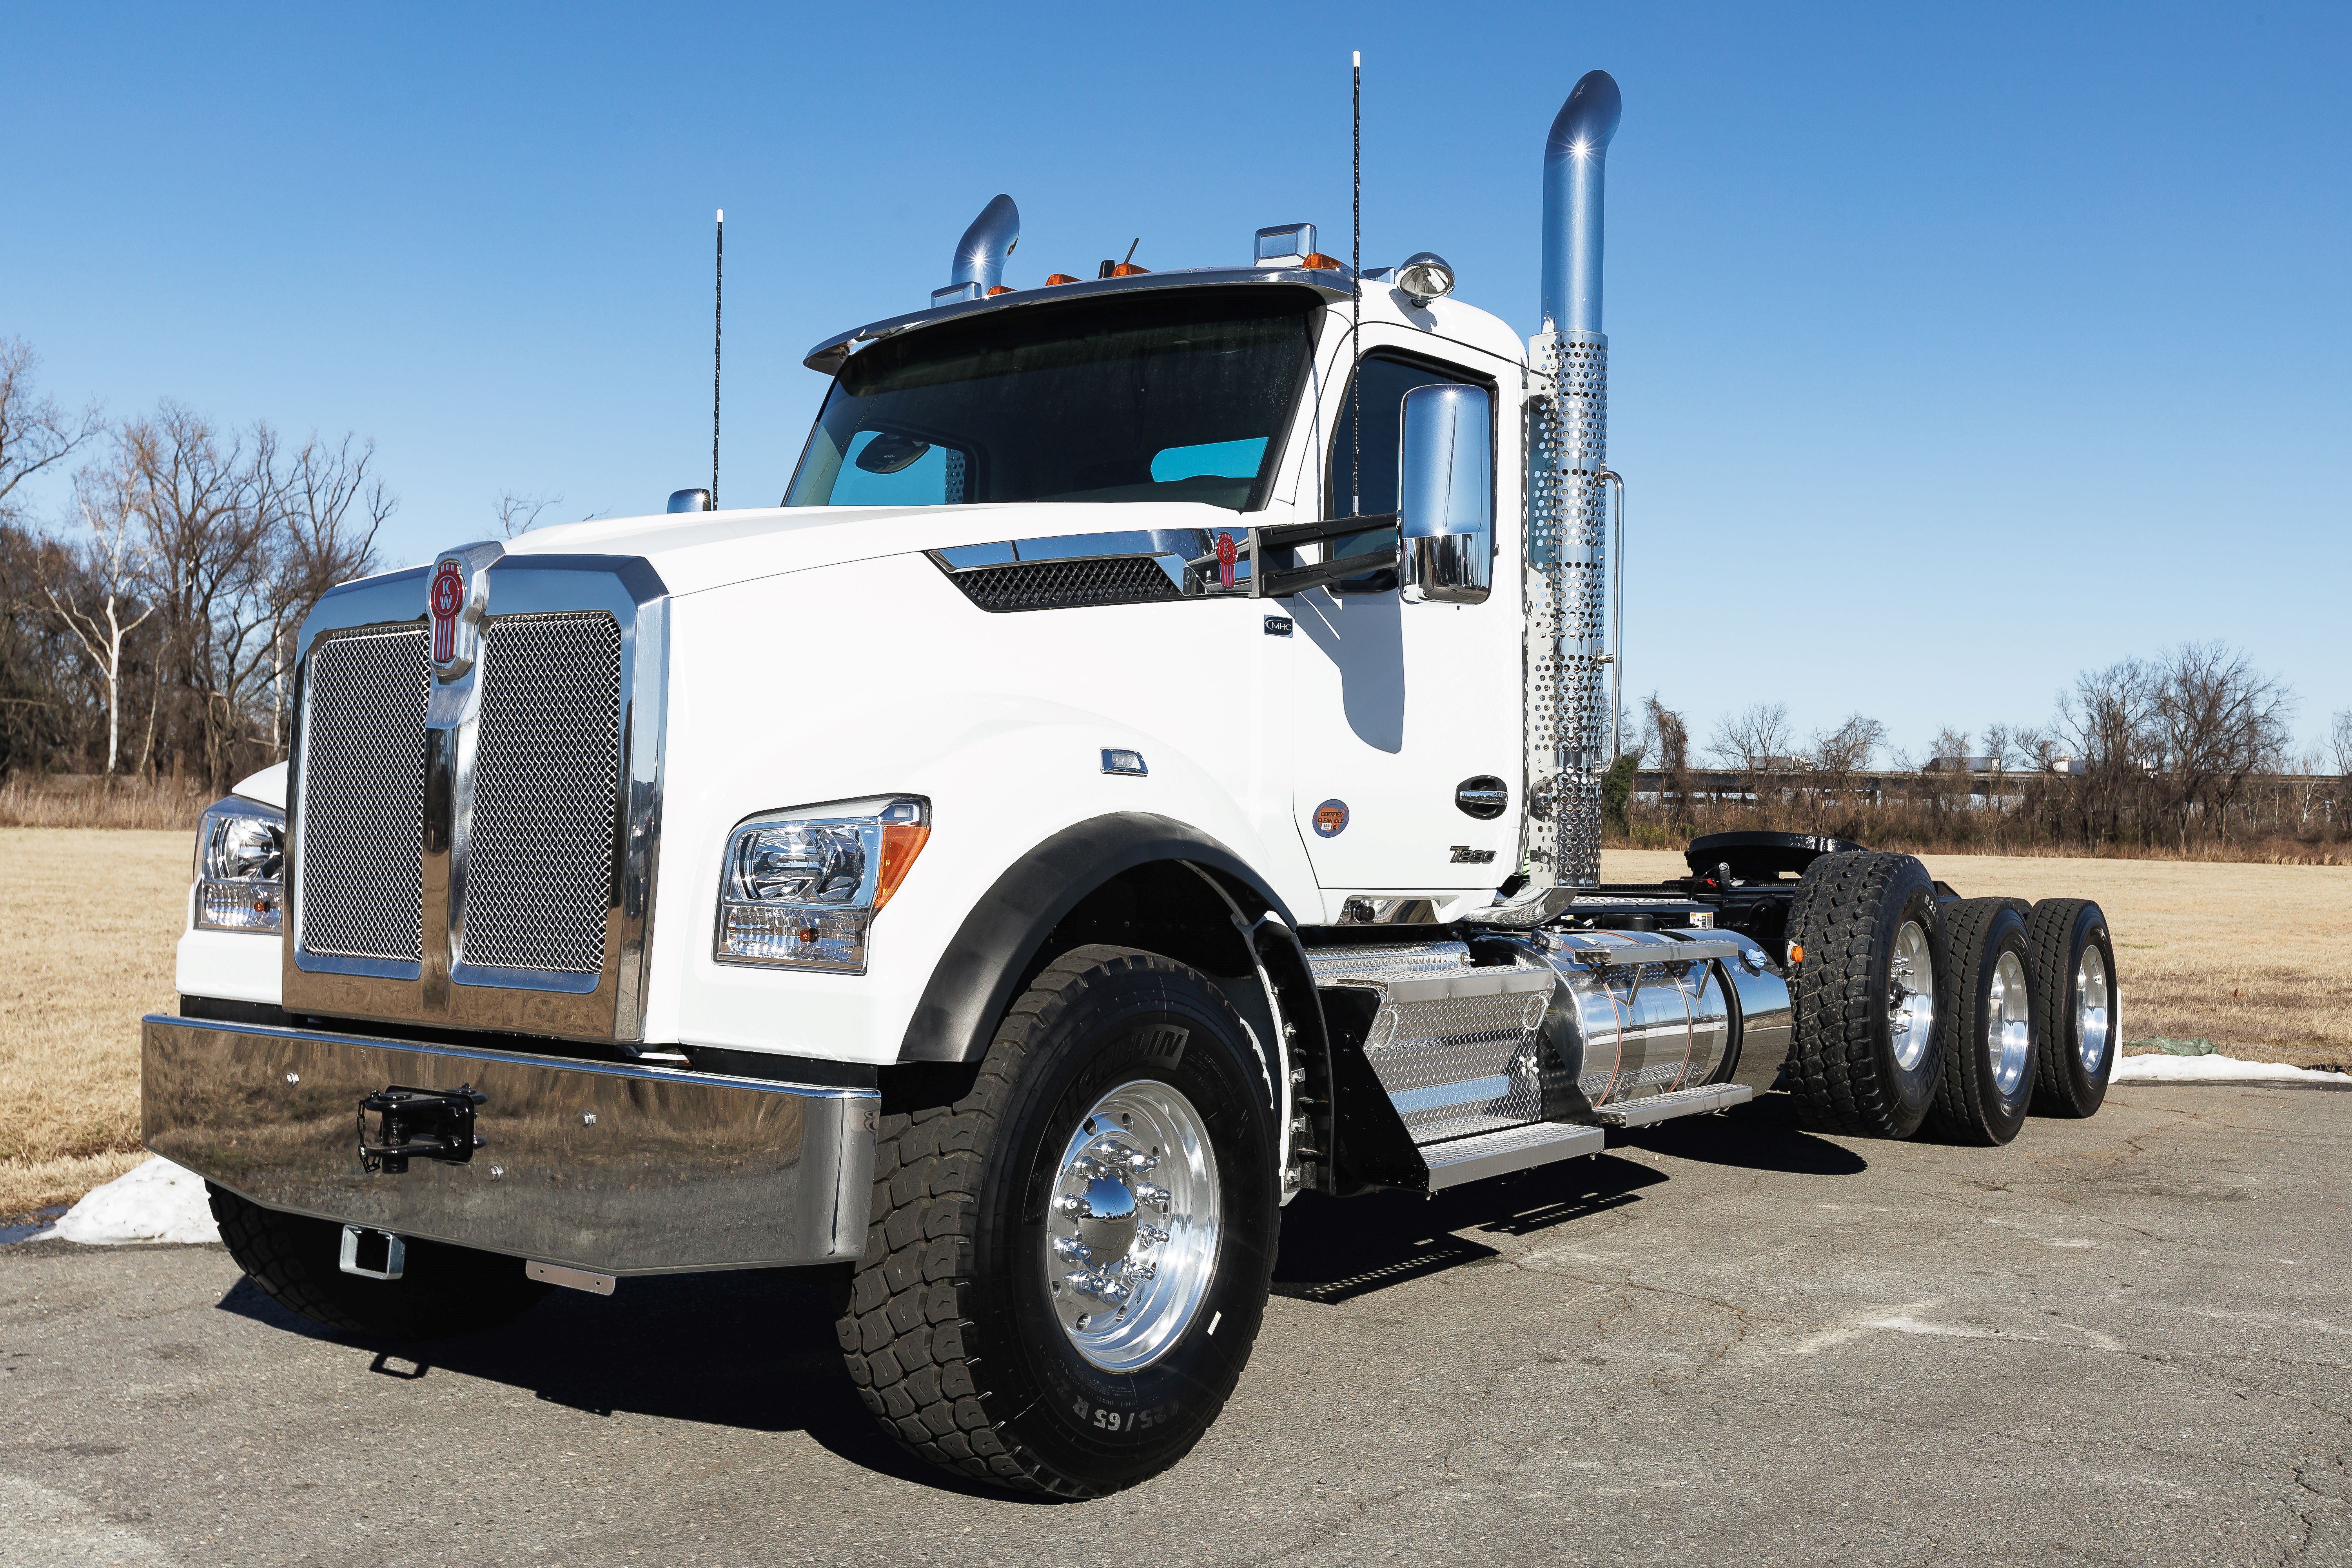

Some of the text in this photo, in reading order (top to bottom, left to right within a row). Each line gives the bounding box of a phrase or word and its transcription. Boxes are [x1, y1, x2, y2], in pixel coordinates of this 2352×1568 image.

[1272, 622, 1292, 631] MHC
[1449, 846, 1497, 864] T880
[1047, 1030, 1185, 1158] MICHELIN
